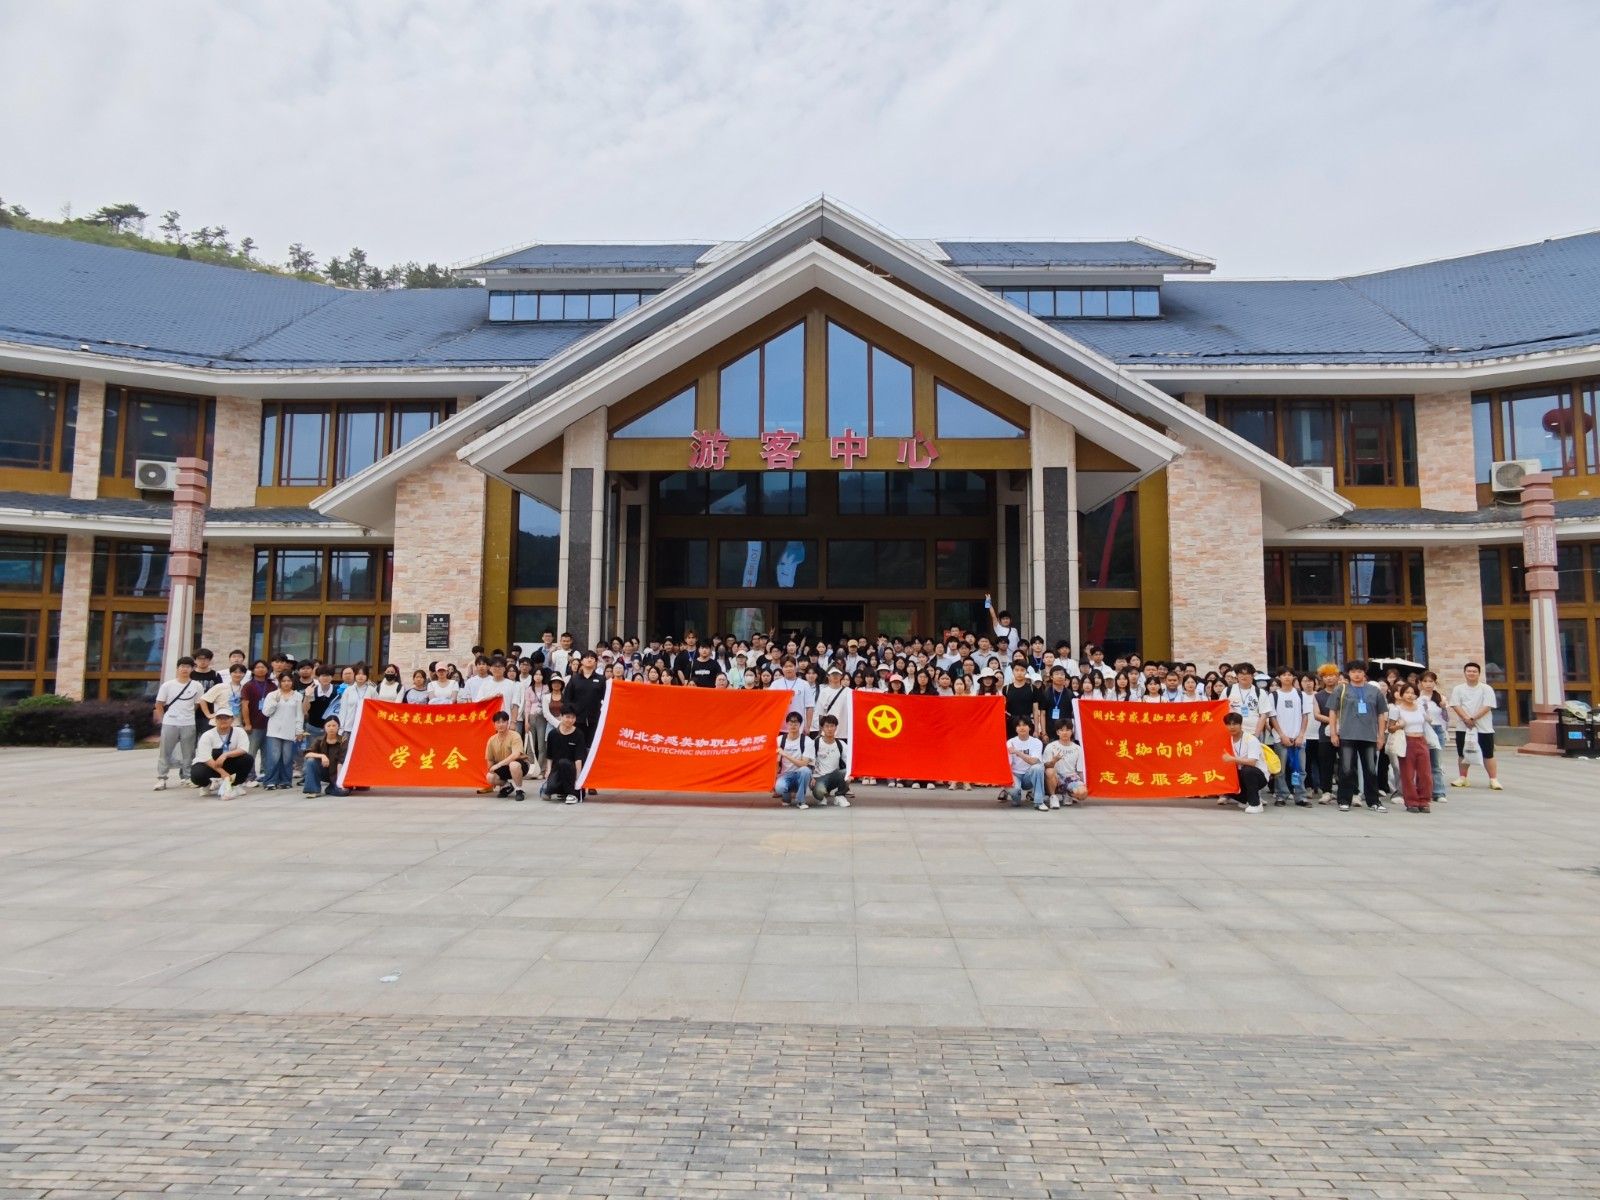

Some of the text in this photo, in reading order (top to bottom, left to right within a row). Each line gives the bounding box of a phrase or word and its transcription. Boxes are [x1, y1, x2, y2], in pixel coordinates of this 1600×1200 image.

[689, 428, 939, 470] 游客中心
[619, 728, 767, 747] 湖北孝感美珈职业学院
[616, 740, 641, 750] MEIGA
[642, 744, 694, 756] POLYTECHNIC
[695, 748, 729, 756] INSTITUTE
[389, 746, 468, 770] 学生会
[1099, 770, 1226, 786] 志愿服务队
